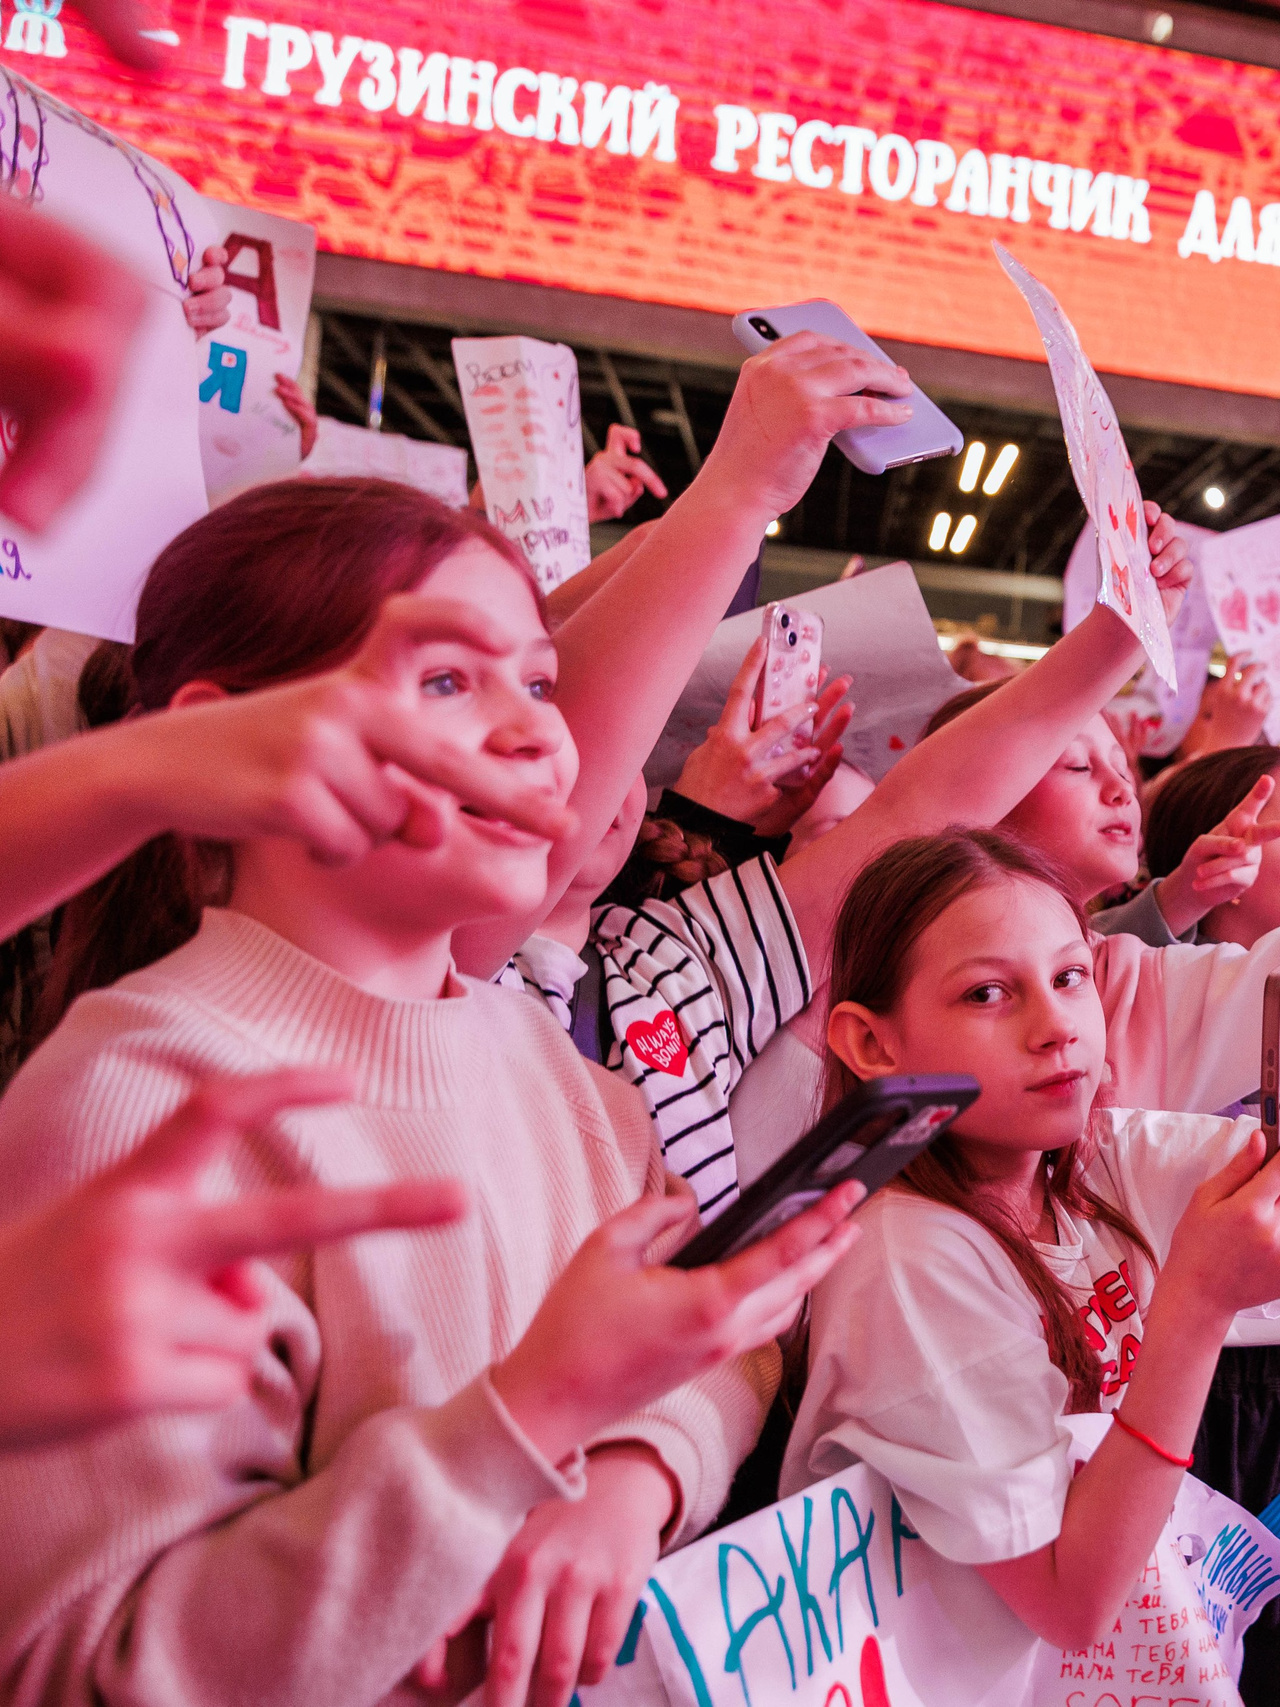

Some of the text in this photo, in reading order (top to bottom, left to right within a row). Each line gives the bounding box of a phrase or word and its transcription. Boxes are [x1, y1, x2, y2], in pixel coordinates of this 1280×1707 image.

[221, 19, 681, 162] ГРУЗИНСКИЙ
[710, 103, 1153, 244] РЕСТОРАНЧИК
[635, 1017, 676, 1056] ALWAYS
[1138, 1607, 1190, 1634] ТЕБЯ
[1130, 1637, 1190, 1663] ТЕБЯ
[1059, 1661, 1116, 1682] МАМА
